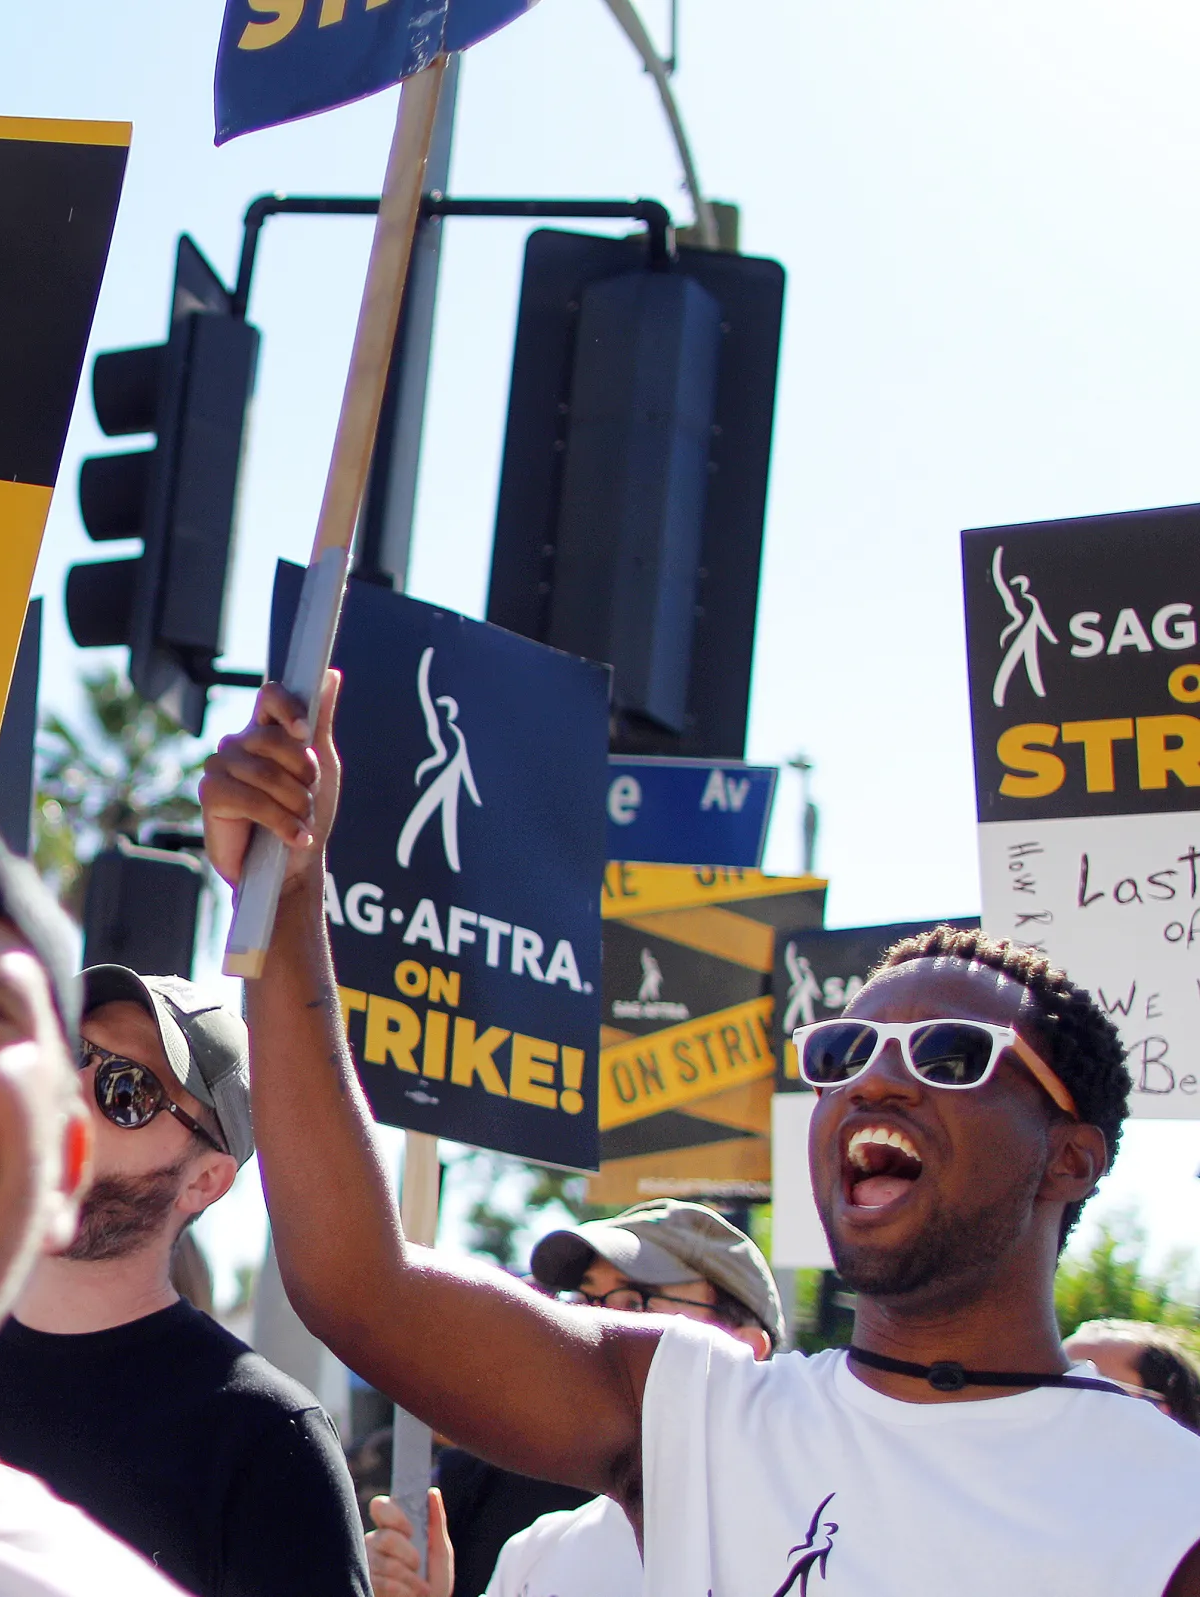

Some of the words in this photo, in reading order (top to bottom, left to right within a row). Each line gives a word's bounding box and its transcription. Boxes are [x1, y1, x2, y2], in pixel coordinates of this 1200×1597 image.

[700, 768, 751, 812] Av
[394, 959, 461, 1007] ON
[612, 1050, 666, 1105] ON
